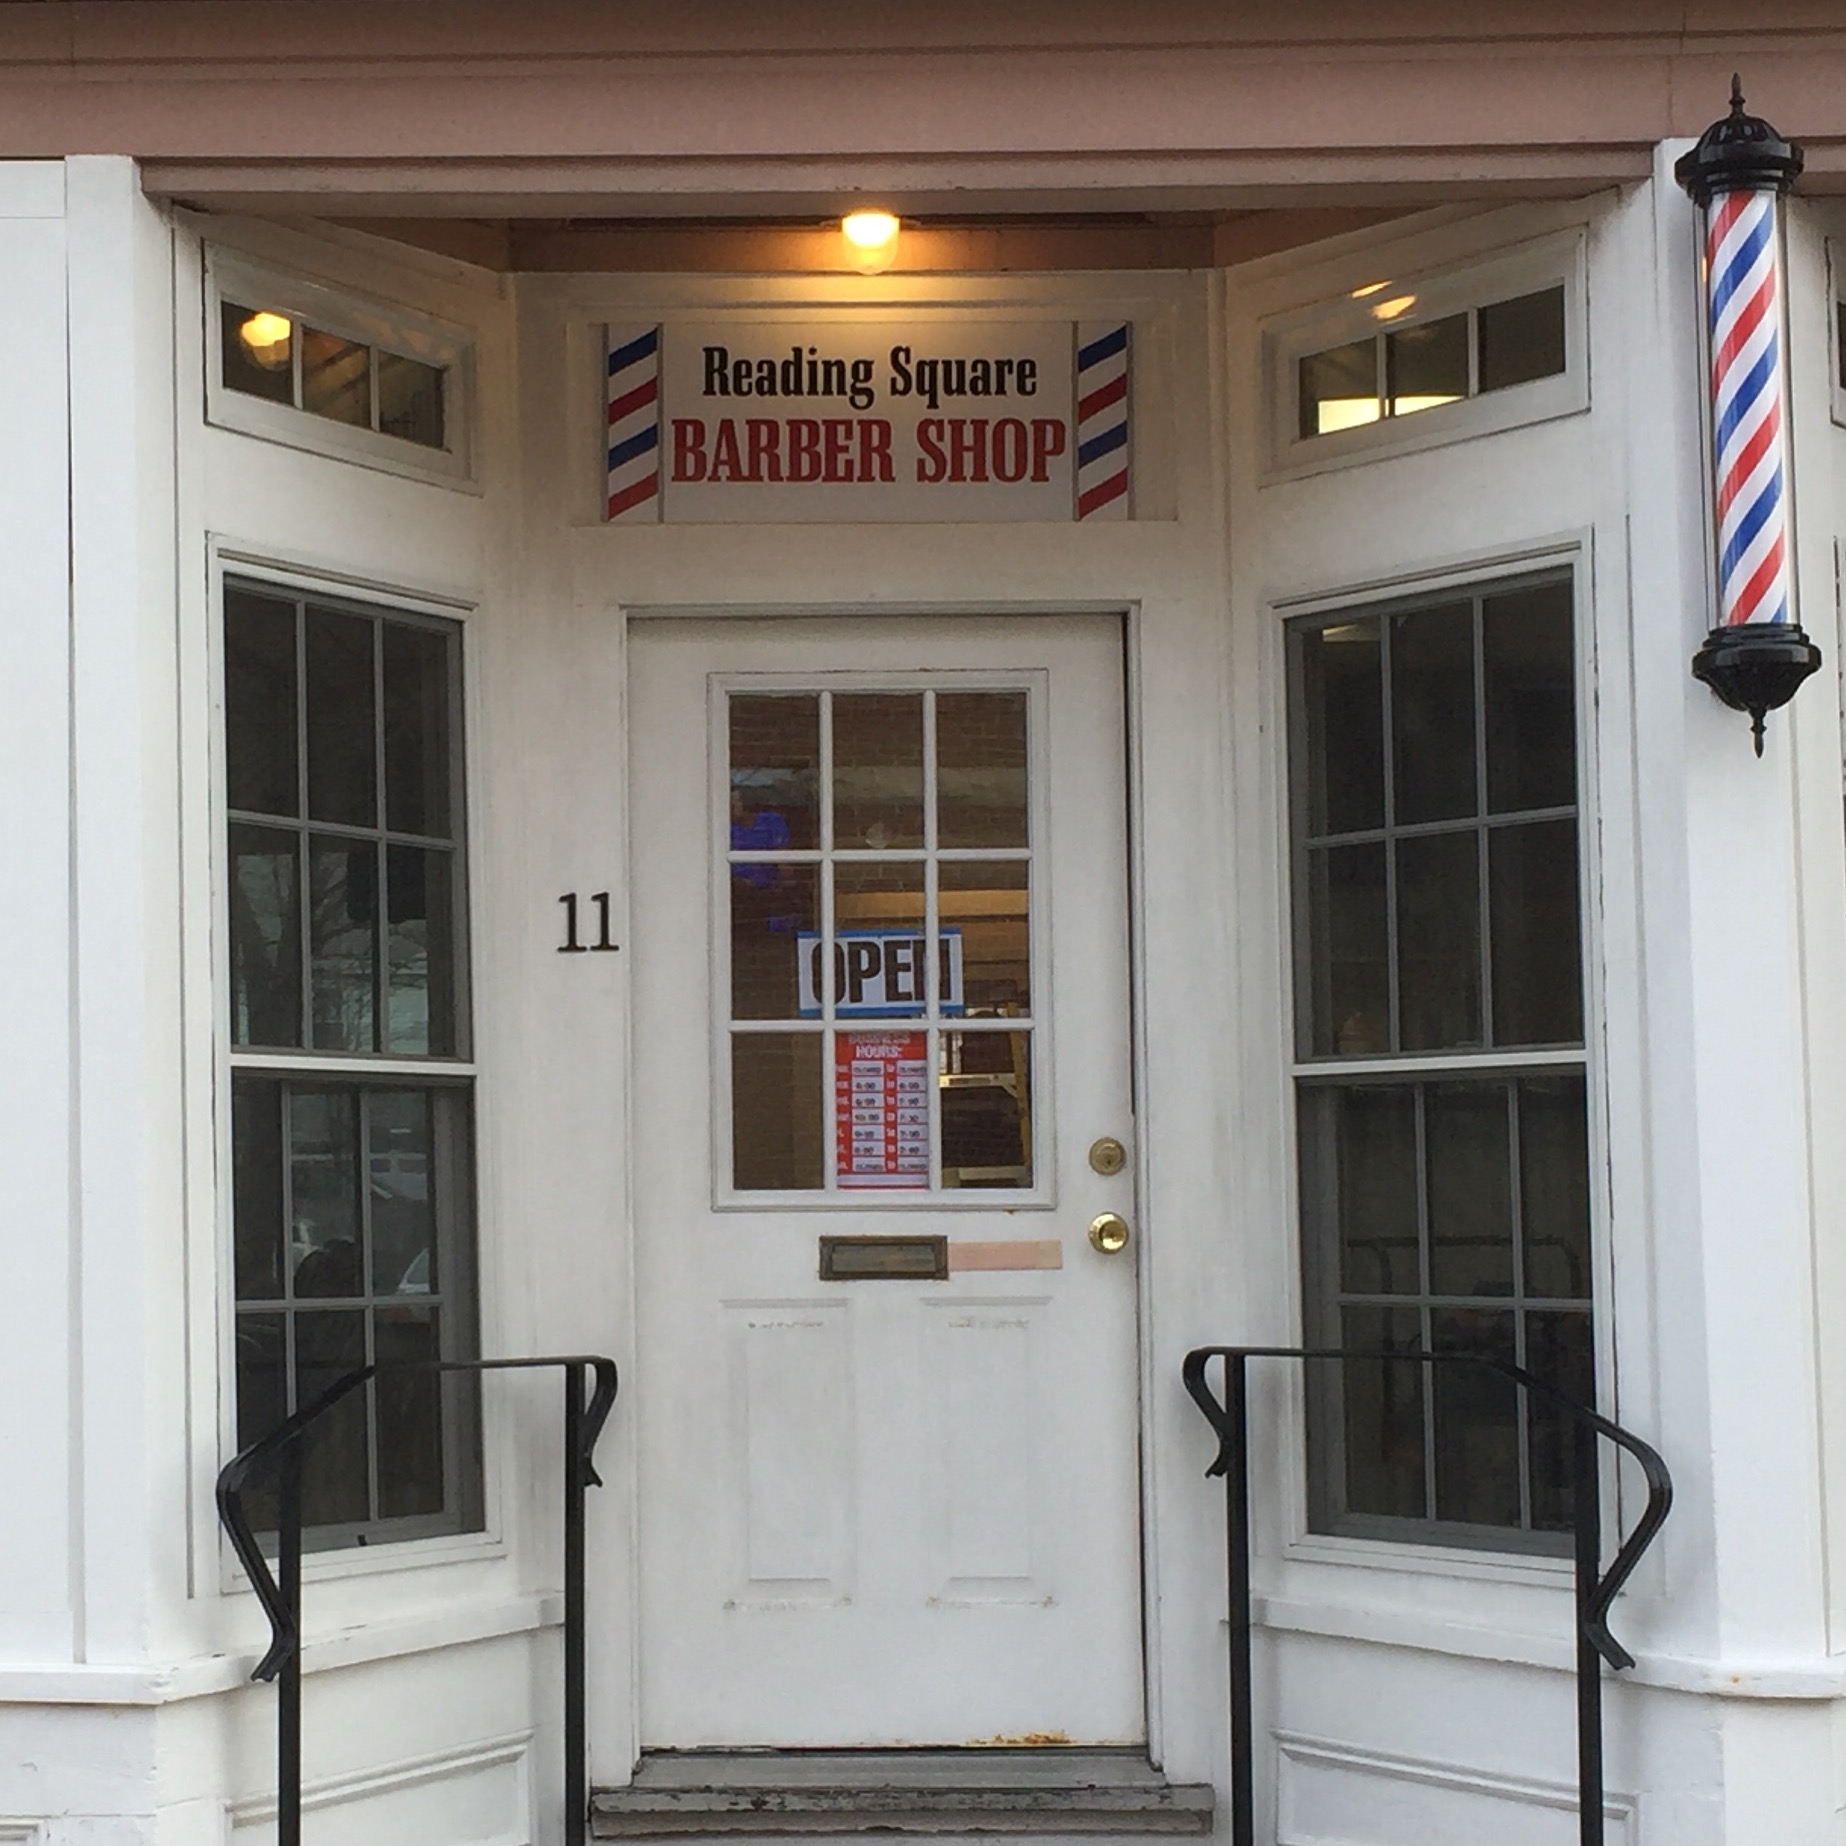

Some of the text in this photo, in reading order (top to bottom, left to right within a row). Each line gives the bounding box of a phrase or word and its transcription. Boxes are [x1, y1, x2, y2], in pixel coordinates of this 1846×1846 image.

[702, 346, 1039, 411] Reading Square
[671, 418, 1067, 483] BARBER SHOP
[557, 892, 619, 953] 11
[811, 939, 951, 1005] OPEN
